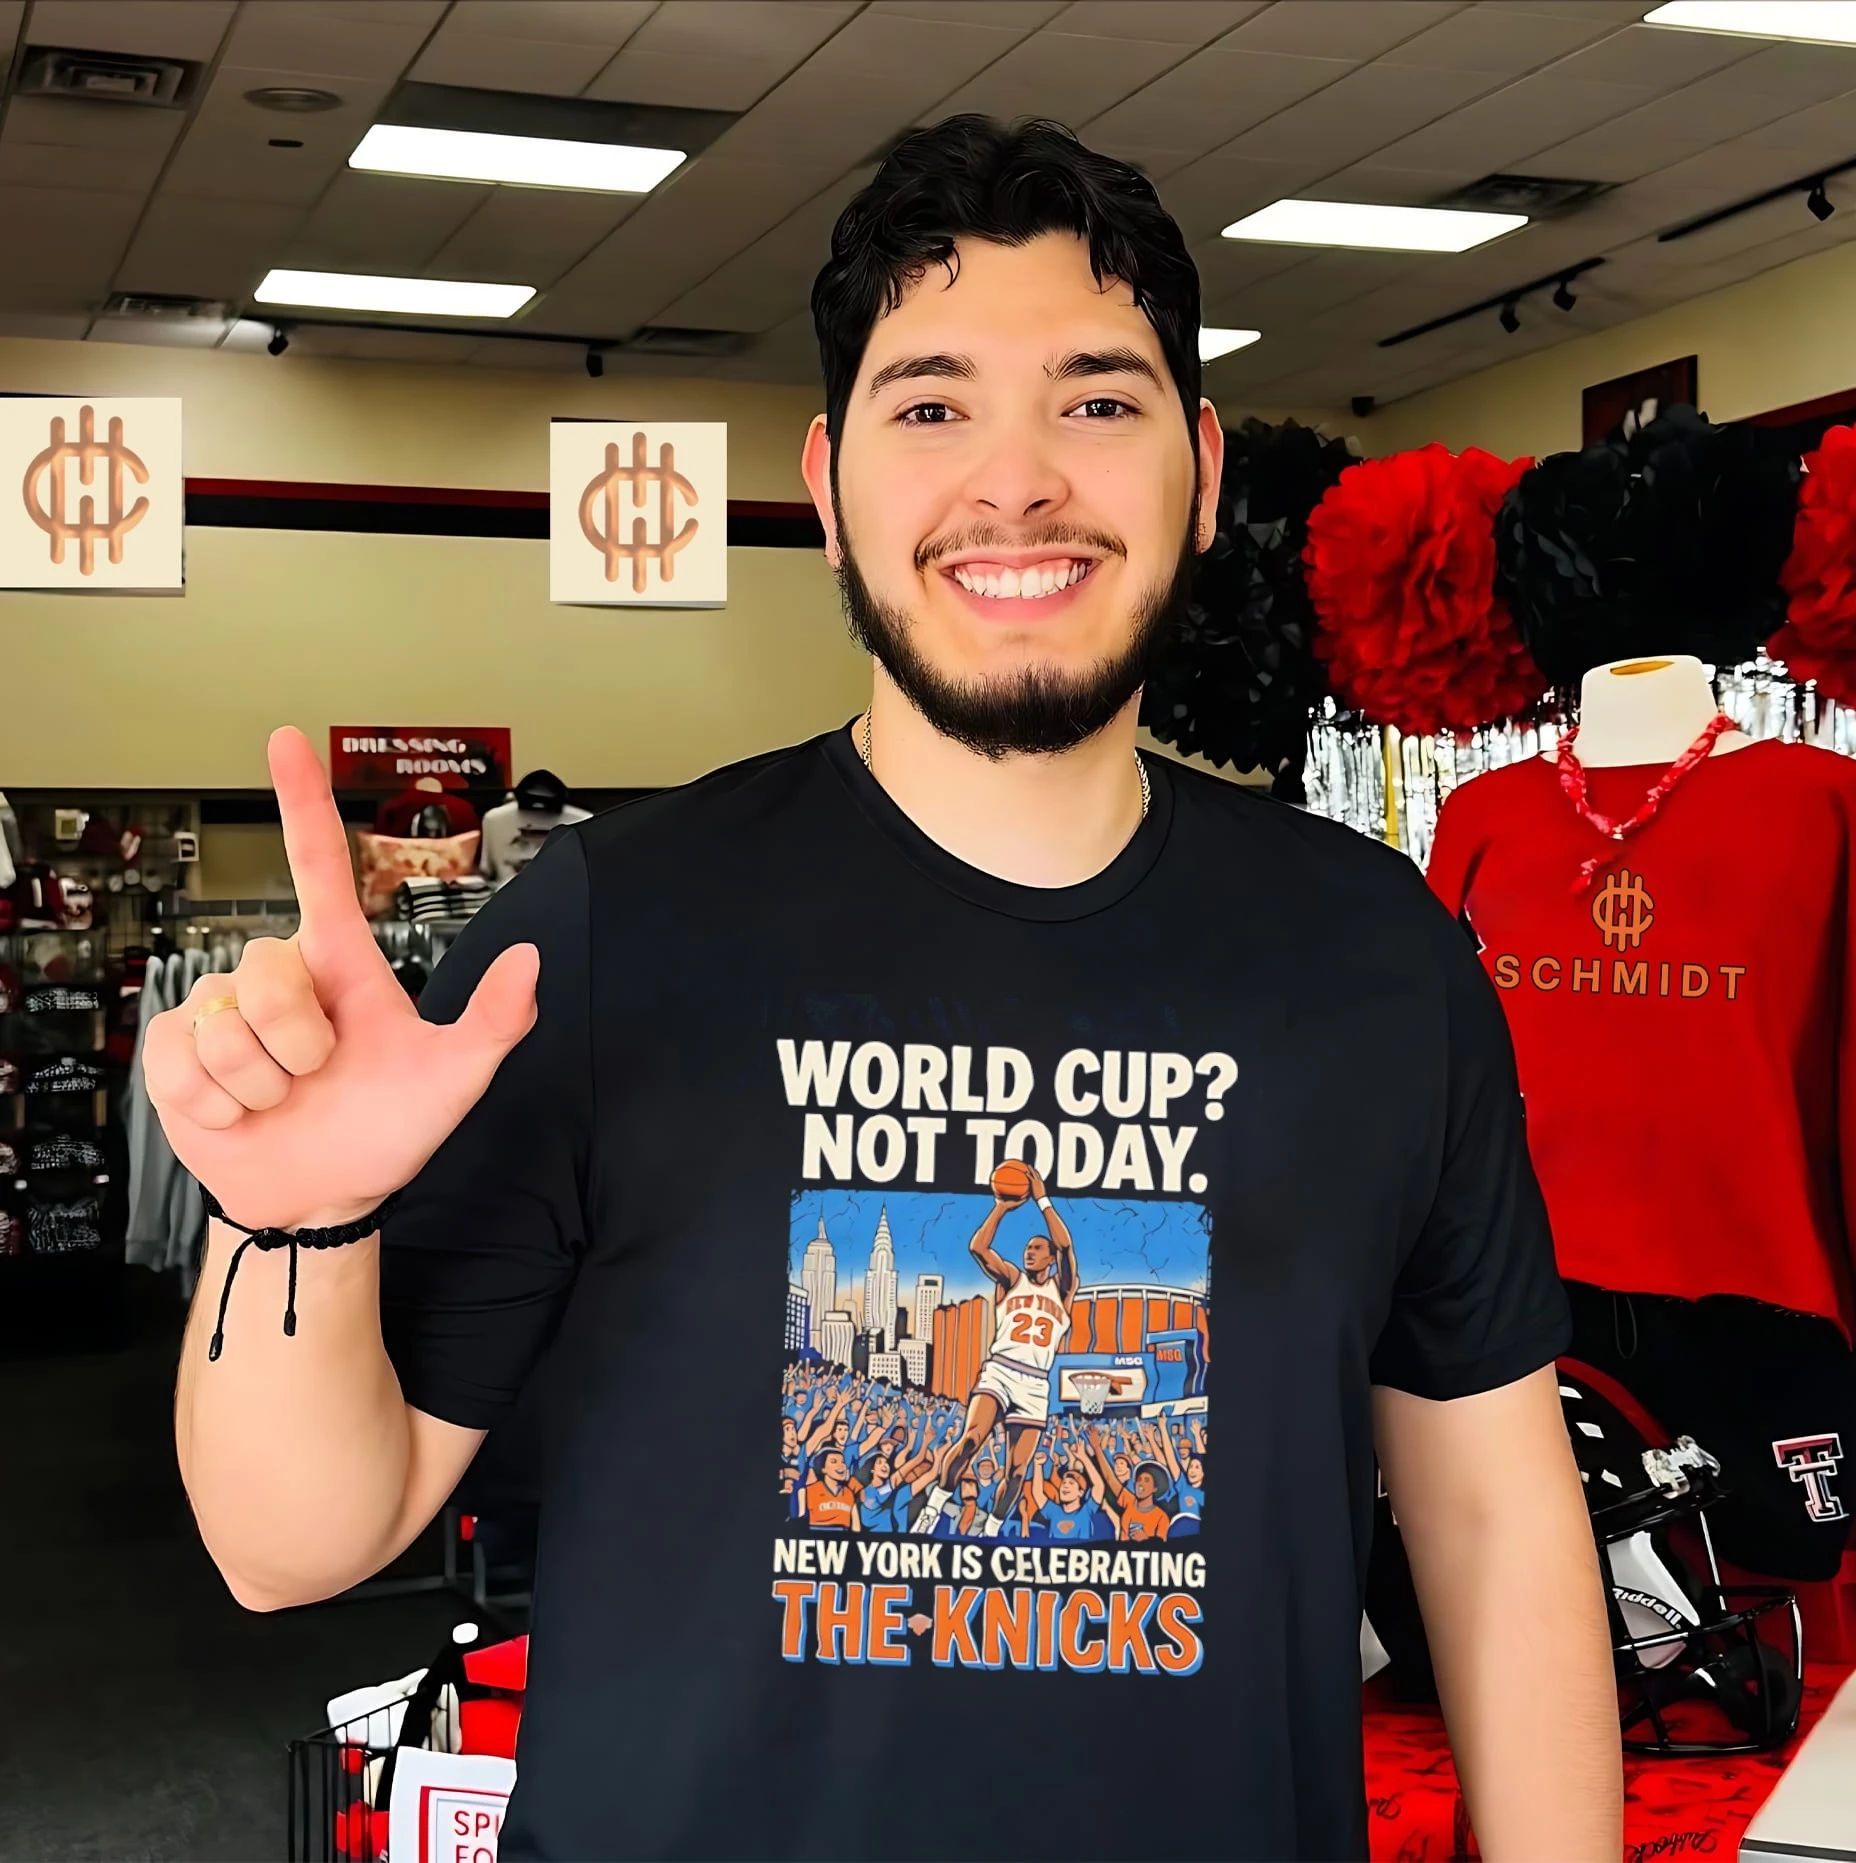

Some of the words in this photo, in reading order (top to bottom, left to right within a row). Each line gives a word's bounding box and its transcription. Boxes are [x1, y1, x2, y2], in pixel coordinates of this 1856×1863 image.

[342, 737, 467, 754] DRESSING
[396, 758, 487, 774] ROOMS
[1494, 954, 1746, 1000] SCHMIDT
[776, 1038, 1035, 1114] WORLD
[1054, 1048, 1239, 1121] CUP?
[802, 1113, 947, 1184] NOT
[965, 1118, 1209, 1194] TODAY.
[1010, 1313, 1055, 1348] 23
[772, 1538, 849, 1576] NEW
[856, 1541, 943, 1580] YORK
[951, 1544, 984, 1581] IS
[990, 1546, 1207, 1588] CELEBRATING
[771, 1579, 912, 1666] THE
[930, 1583, 1206, 1678] KNICKS
[1612, 1587, 1682, 1629] Riddell
